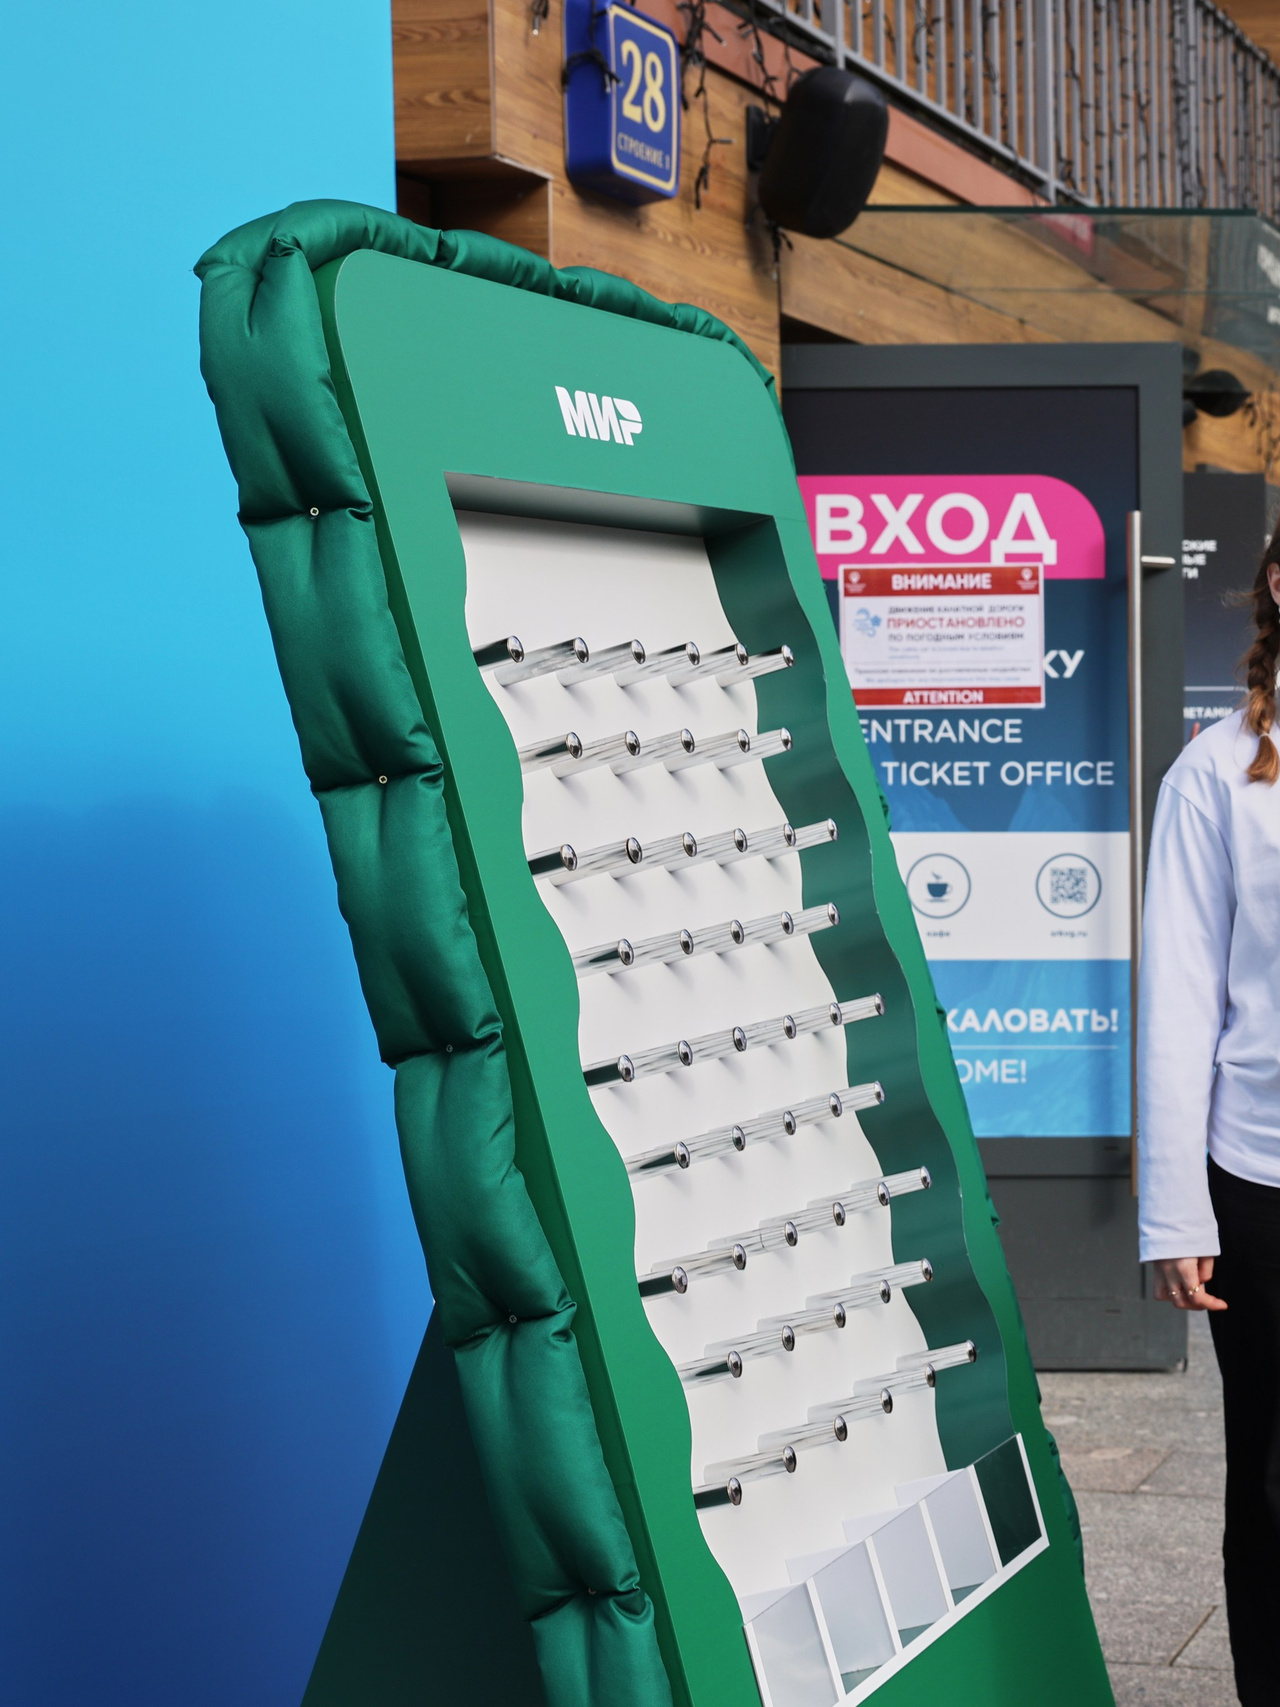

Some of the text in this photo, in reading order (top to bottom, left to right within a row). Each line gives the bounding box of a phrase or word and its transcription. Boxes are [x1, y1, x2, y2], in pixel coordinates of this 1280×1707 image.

[621, 39, 666, 133] 28
[554, 385, 643, 446] МИР
[815, 492, 1057, 565] ВХОД
[891, 572, 992, 591] ВНИМАНИЕ
[887, 616, 1026, 630] ПРИОСТАНОВЛЕНО
[902, 689, 984, 705] ATTENTION
[880, 761, 1115, 786] TICKET OFFICE
